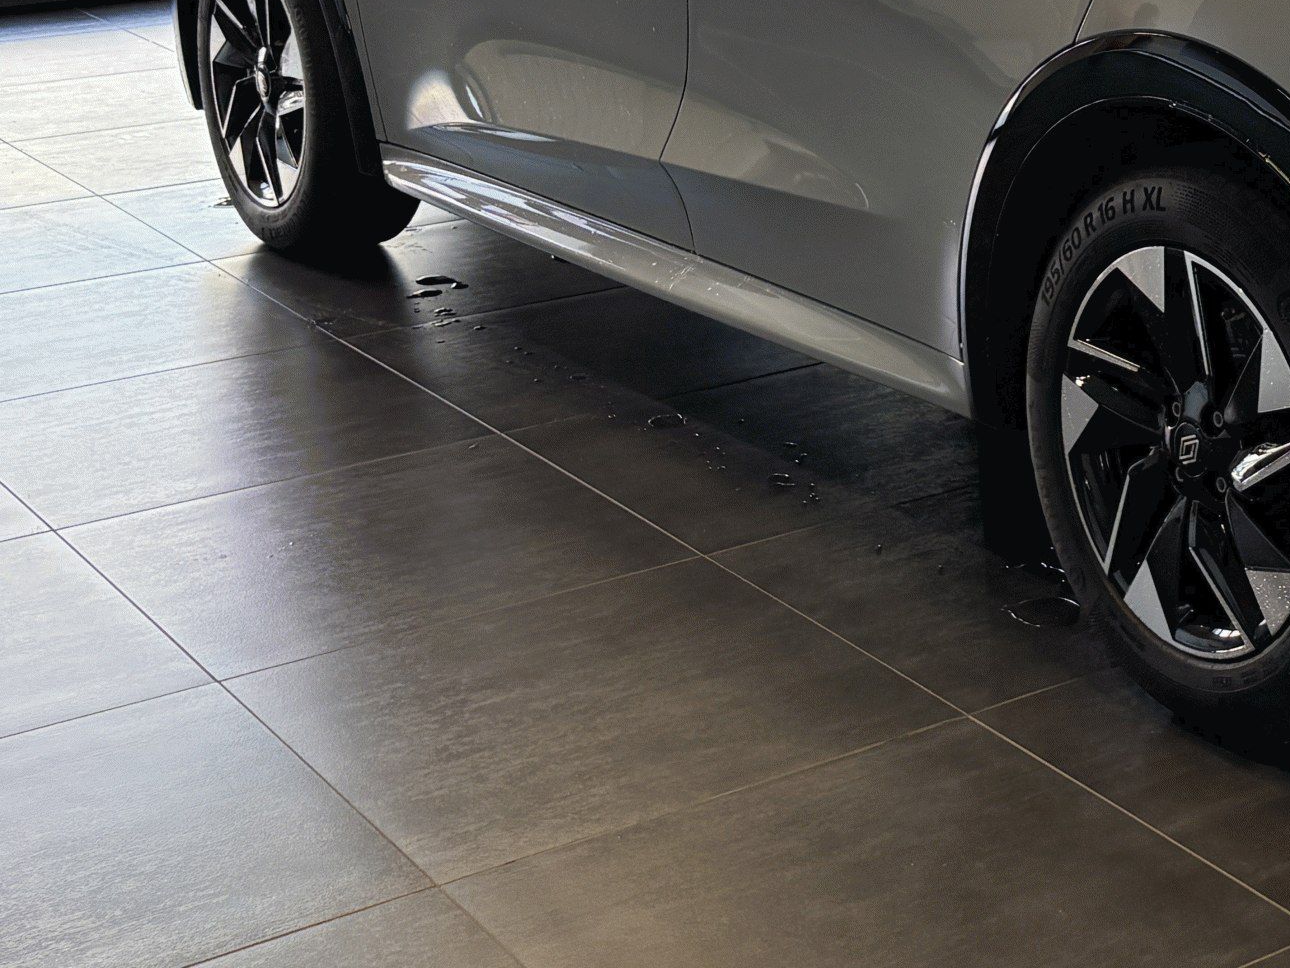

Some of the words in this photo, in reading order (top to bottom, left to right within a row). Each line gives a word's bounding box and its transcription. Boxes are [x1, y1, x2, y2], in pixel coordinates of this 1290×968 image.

[1041, 227, 1082, 306] 195/60
[1083, 212, 1097, 237] R
[1098, 196, 1116, 225] 16
[1122, 188, 1135, 215] H
[1142, 185, 1167, 212] XL
